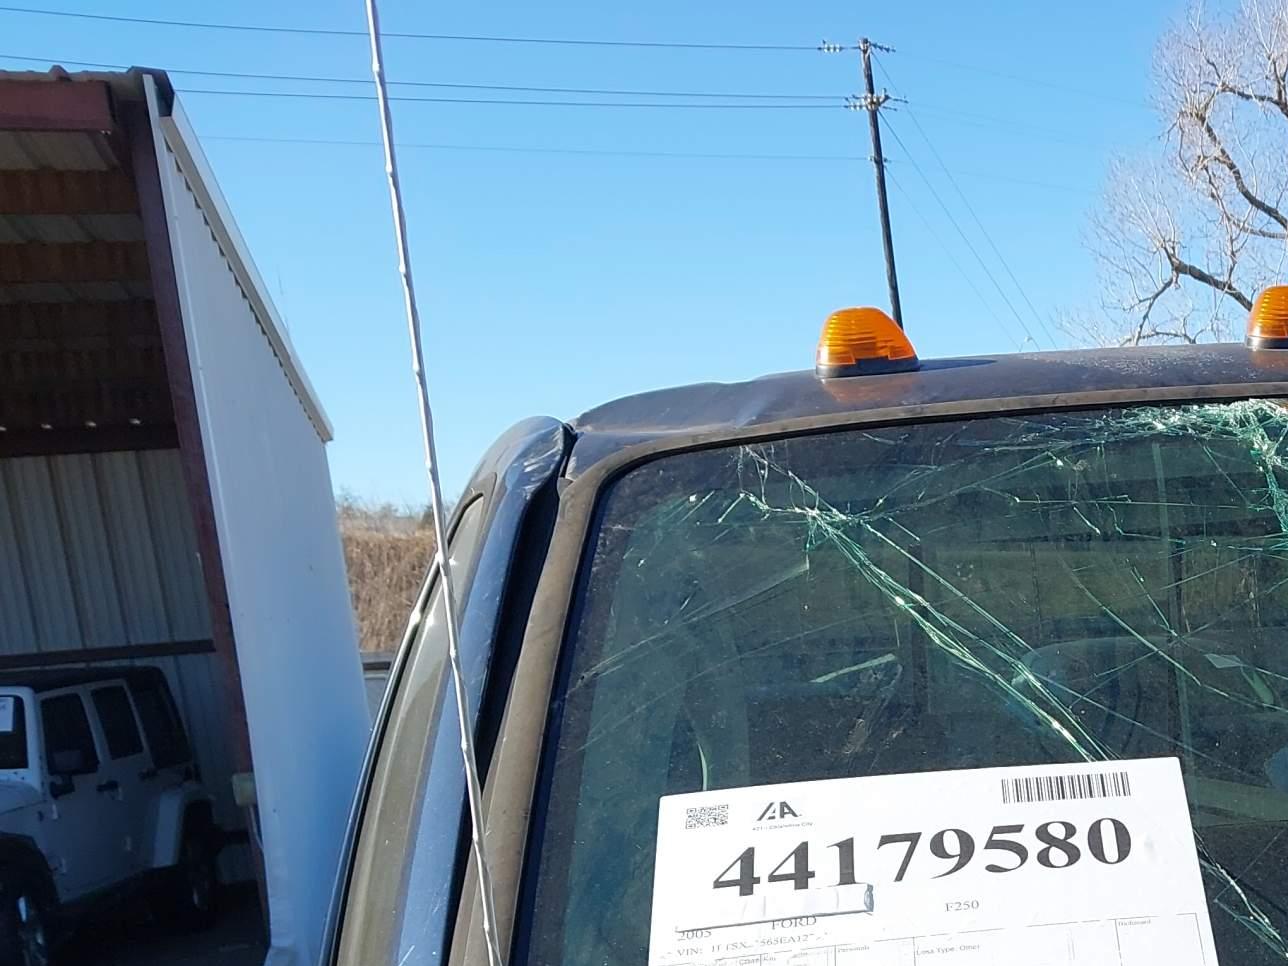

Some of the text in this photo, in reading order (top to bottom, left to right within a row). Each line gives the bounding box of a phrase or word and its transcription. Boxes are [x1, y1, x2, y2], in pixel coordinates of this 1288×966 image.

[713, 817, 1132, 897] 44179580
[945, 899, 980, 912] F250
[771, 916, 817, 930] FORD
